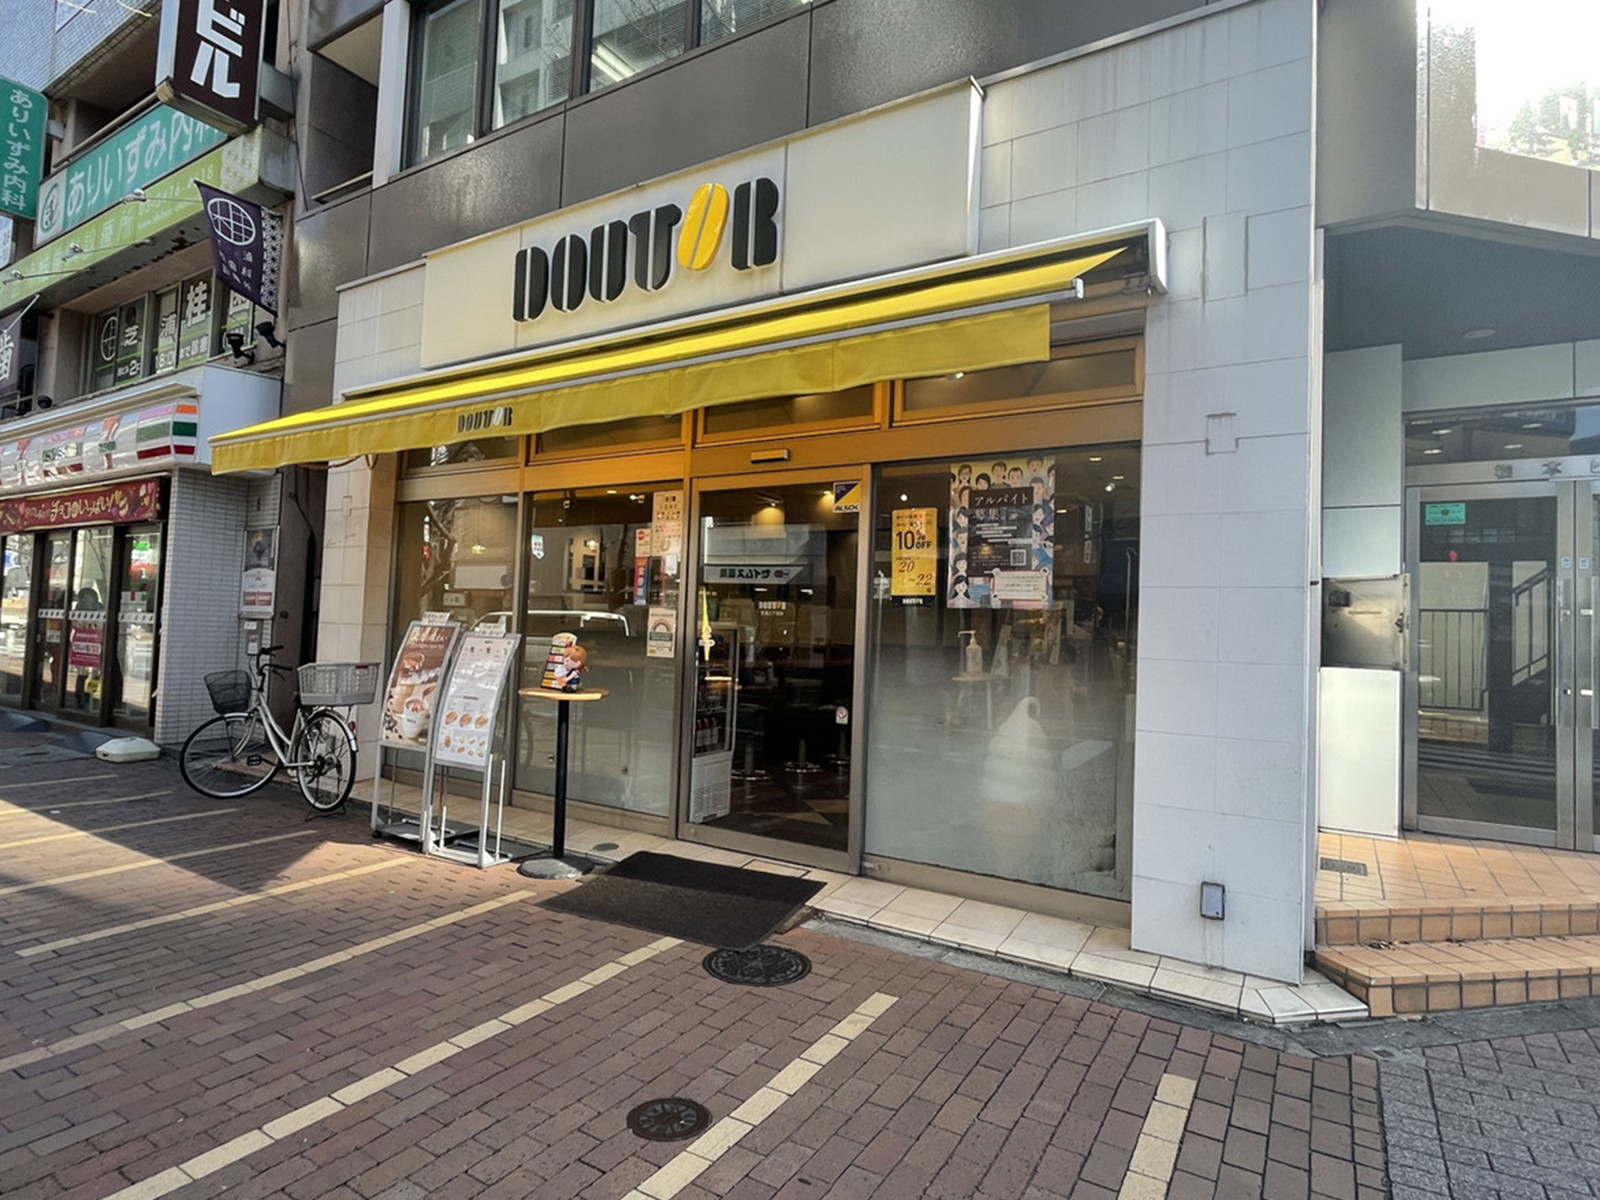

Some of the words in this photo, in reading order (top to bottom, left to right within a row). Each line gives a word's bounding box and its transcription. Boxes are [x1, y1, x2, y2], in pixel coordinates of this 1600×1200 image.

[2, 89, 33, 211] ありいずみ内科
[512, 177, 779, 322] DOUTOR
[457, 406, 513, 433] DOUTOR
[974, 493, 1029, 507] アルバイト
[916, 541, 932, 550] OFF
